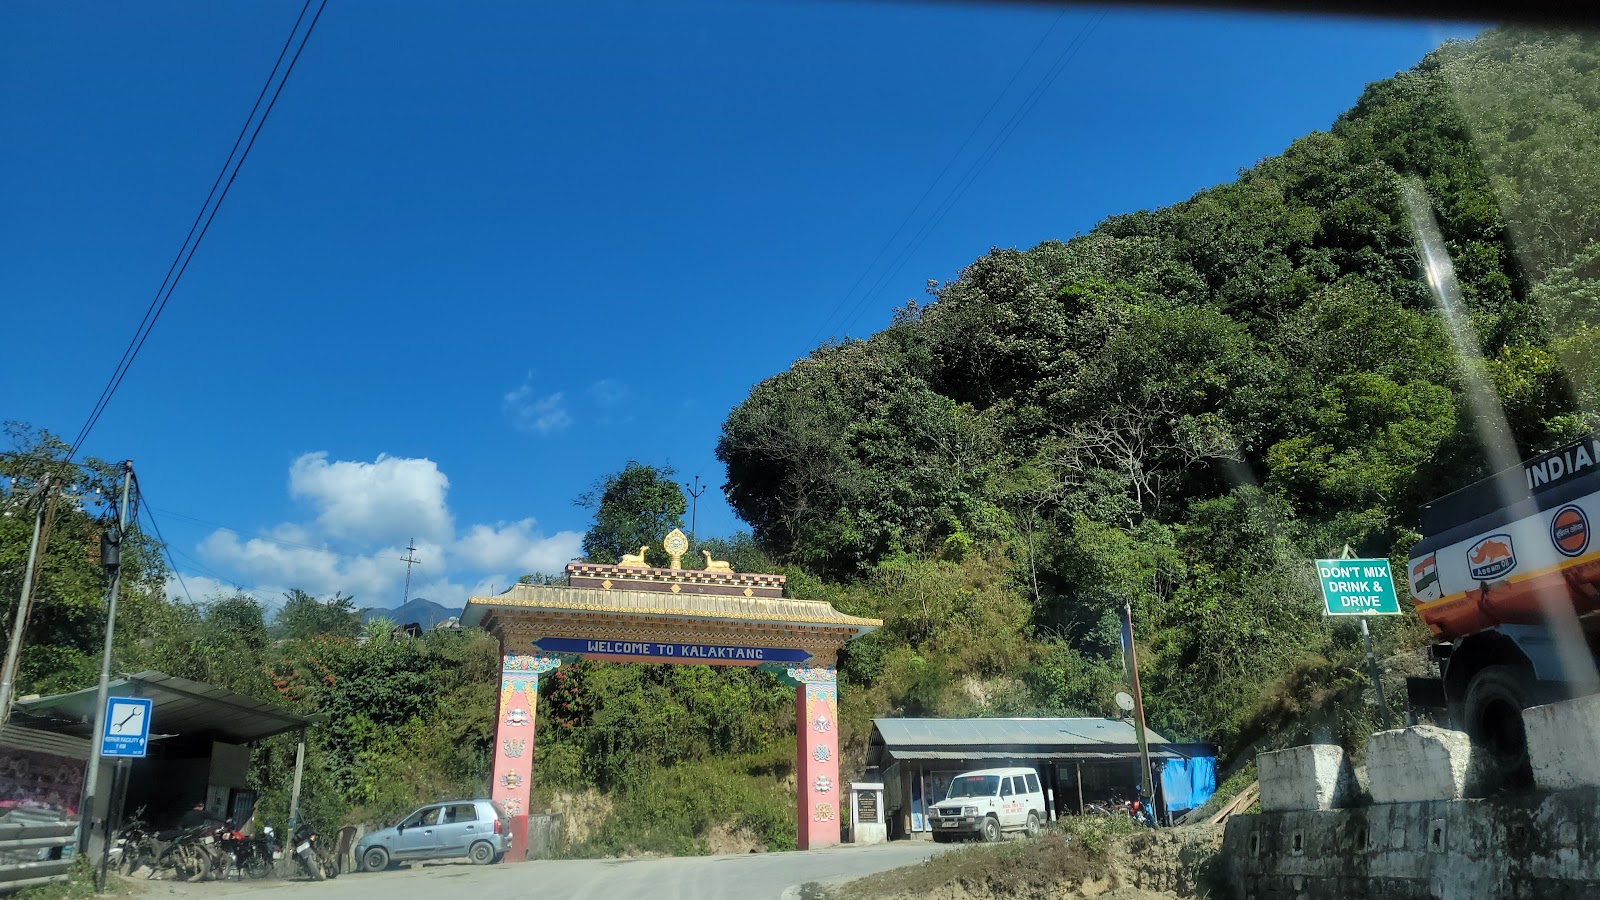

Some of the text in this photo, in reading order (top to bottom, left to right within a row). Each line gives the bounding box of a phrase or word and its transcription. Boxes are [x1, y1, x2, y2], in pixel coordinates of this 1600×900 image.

[1320, 566, 1389, 579] DON'T MIX
[1328, 581, 1384, 593] DRINK &
[1340, 595, 1382, 607] DRIVE
[587, 640, 763, 660] WELCOME TO KALAKTANG
